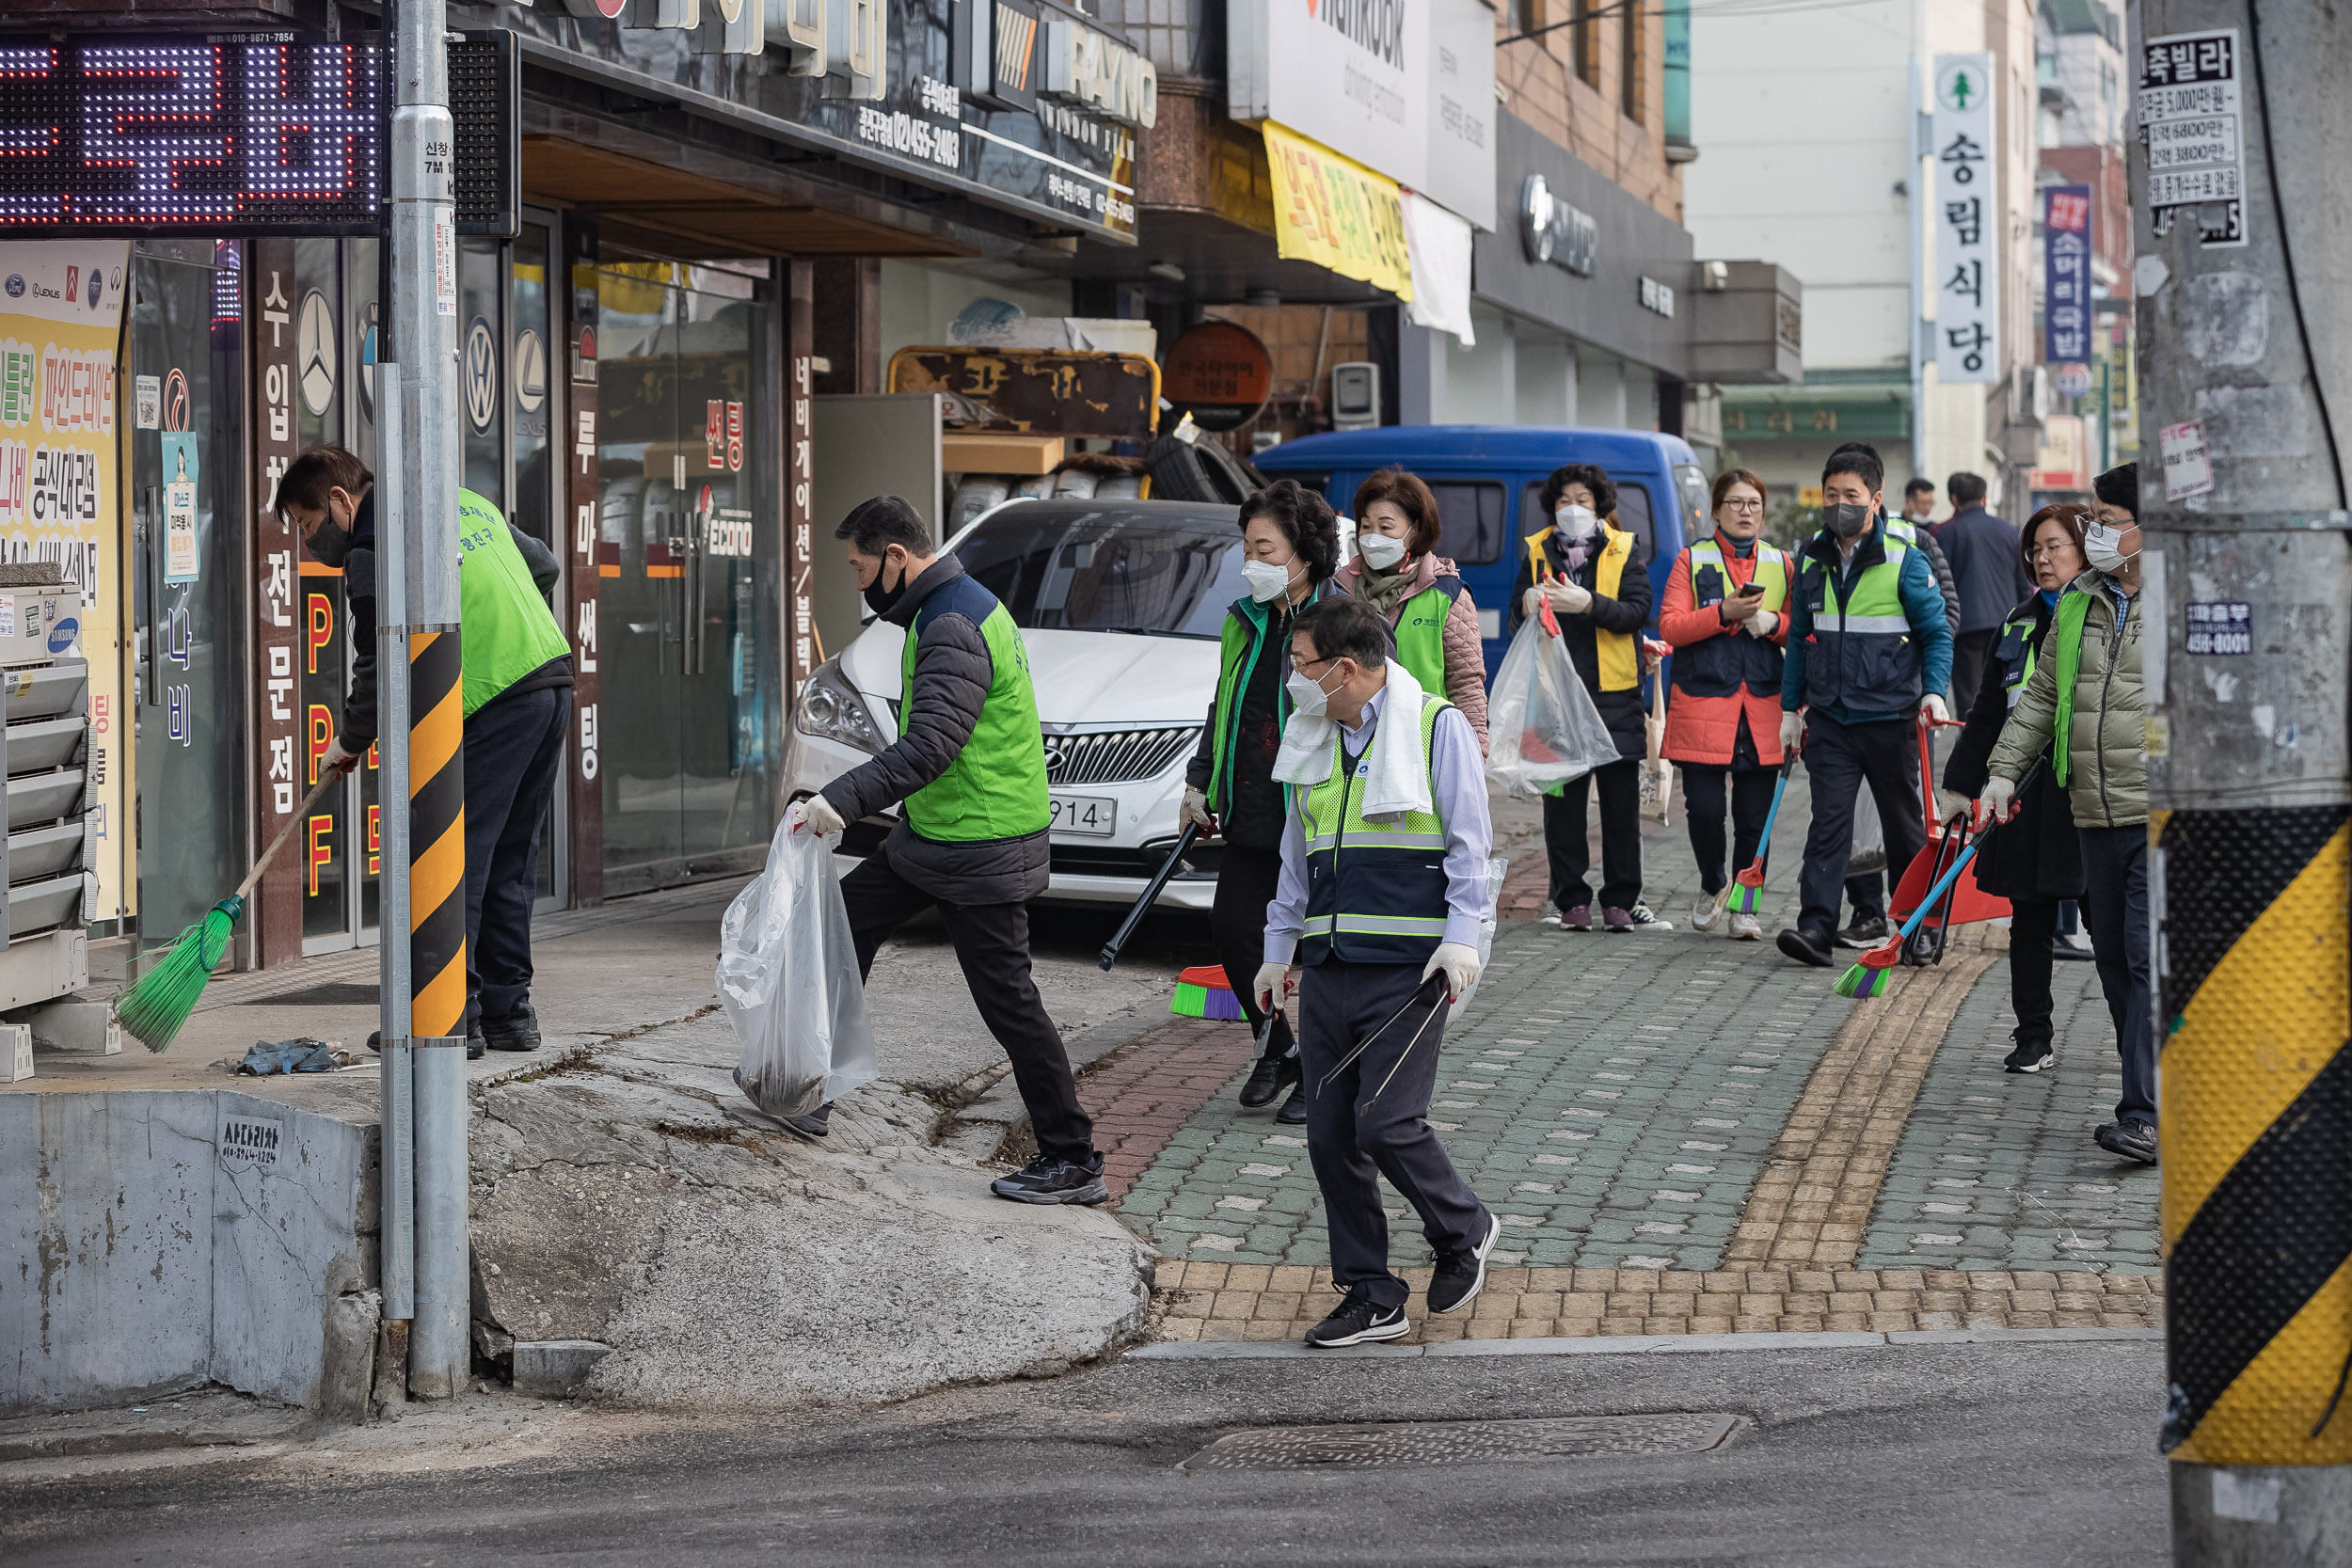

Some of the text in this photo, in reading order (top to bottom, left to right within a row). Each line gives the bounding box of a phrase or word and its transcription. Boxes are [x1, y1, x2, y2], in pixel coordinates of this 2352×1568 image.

[232, 32, 294, 43] 010-9871-7854
[1068, 20, 1157, 129] RAYNO
[1940, 133, 1992, 372] 송림식당
[2051, 232, 2086, 358] 소머리국밥
[706, 399, 744, 472] 썬팅
[34, 451, 96, 520] 공식대리점
[460, 527, 495, 552] 광진구
[51, 628, 76, 642] SAMSUNG
[1049, 800, 1099, 828] 914
[224, 1120, 280, 1150] 사다리차
[222, 1146, 277, 1165] 010-8964-1224
